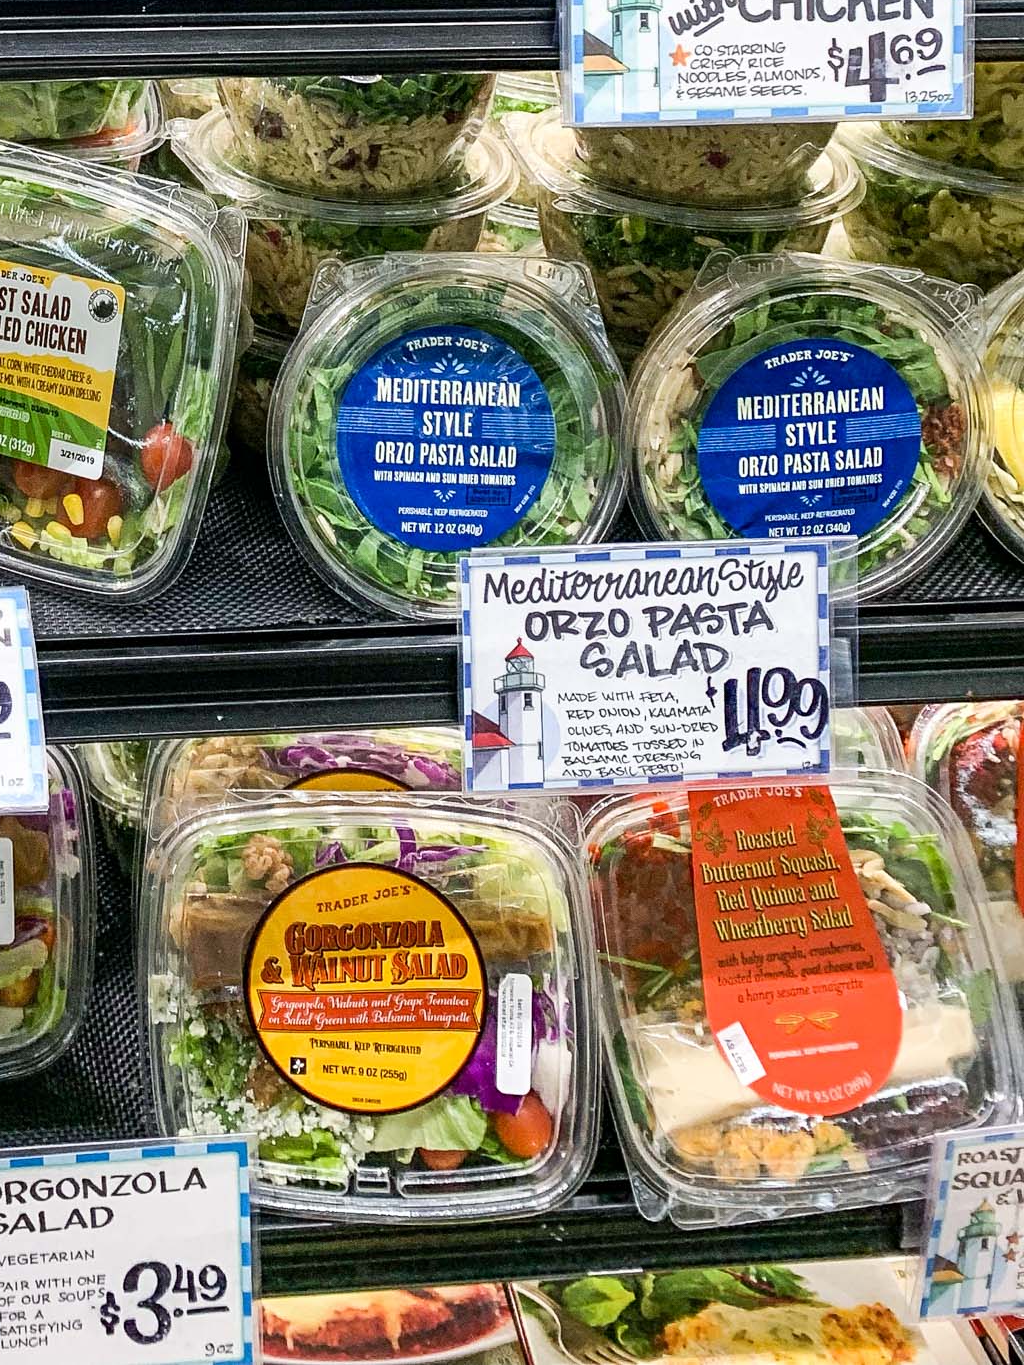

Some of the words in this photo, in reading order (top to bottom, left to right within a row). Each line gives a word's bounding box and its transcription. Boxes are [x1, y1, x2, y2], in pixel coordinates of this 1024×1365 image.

[678, 72, 751, 84] NOODLES,
[754, 68, 825, 82] ALMONDS,
[690, 58, 743, 69] CRISPY
[749, 57, 784, 67] RICE
[21, 272, 46, 284] JOE'S
[22, 291, 71, 320] SALAD
[25, 322, 87, 354] CHICKEN
[407, 337, 452, 352] TRADER
[456, 337, 489, 352] JOE'S
[377, 377, 520, 407] MEDITERRANEAN
[422, 412, 473, 437] STYLE
[9, 437, 35, 456] (312g)
[60, 449, 94, 465] 3/21/2019
[375, 442, 414, 464] ORZO
[420, 444, 464, 466] PASTA
[470, 445, 517, 468] SALAD
[525, 608, 630, 641] ORZO
[643, 601, 774, 638] PASTA
[580, 640, 730, 678] SALAD
[565, 740, 628, 752] TOMATOES
[632, 739, 687, 750] TOSSED
[736, 824, 796, 851] Roasted
[702, 858, 777, 884] Butternut
[780, 851, 840, 878] Squash,
[317, 893, 368, 913] TRADER
[373, 885, 411, 901] JOE'S
[717, 887, 749, 912] Red
[752, 884, 805, 910] Quinoa
[811, 879, 839, 902] and
[714, 912, 808, 942] Wheatberry
[810, 906, 853, 930] Salad
[285, 920, 444, 955] GORGONZOLA
[261, 957, 283, 984] &
[288, 951, 386, 991] WALNUT
[391, 950, 467, 984] SALAD
[371, 997, 390, 1007] and
[393, 994, 423, 1013] Grape
[427, 992, 469, 1007] Tomatoes
[0, 1320, 82, 1335] SATISFYING
[2, 1336, 48, 1348] LUNCH
